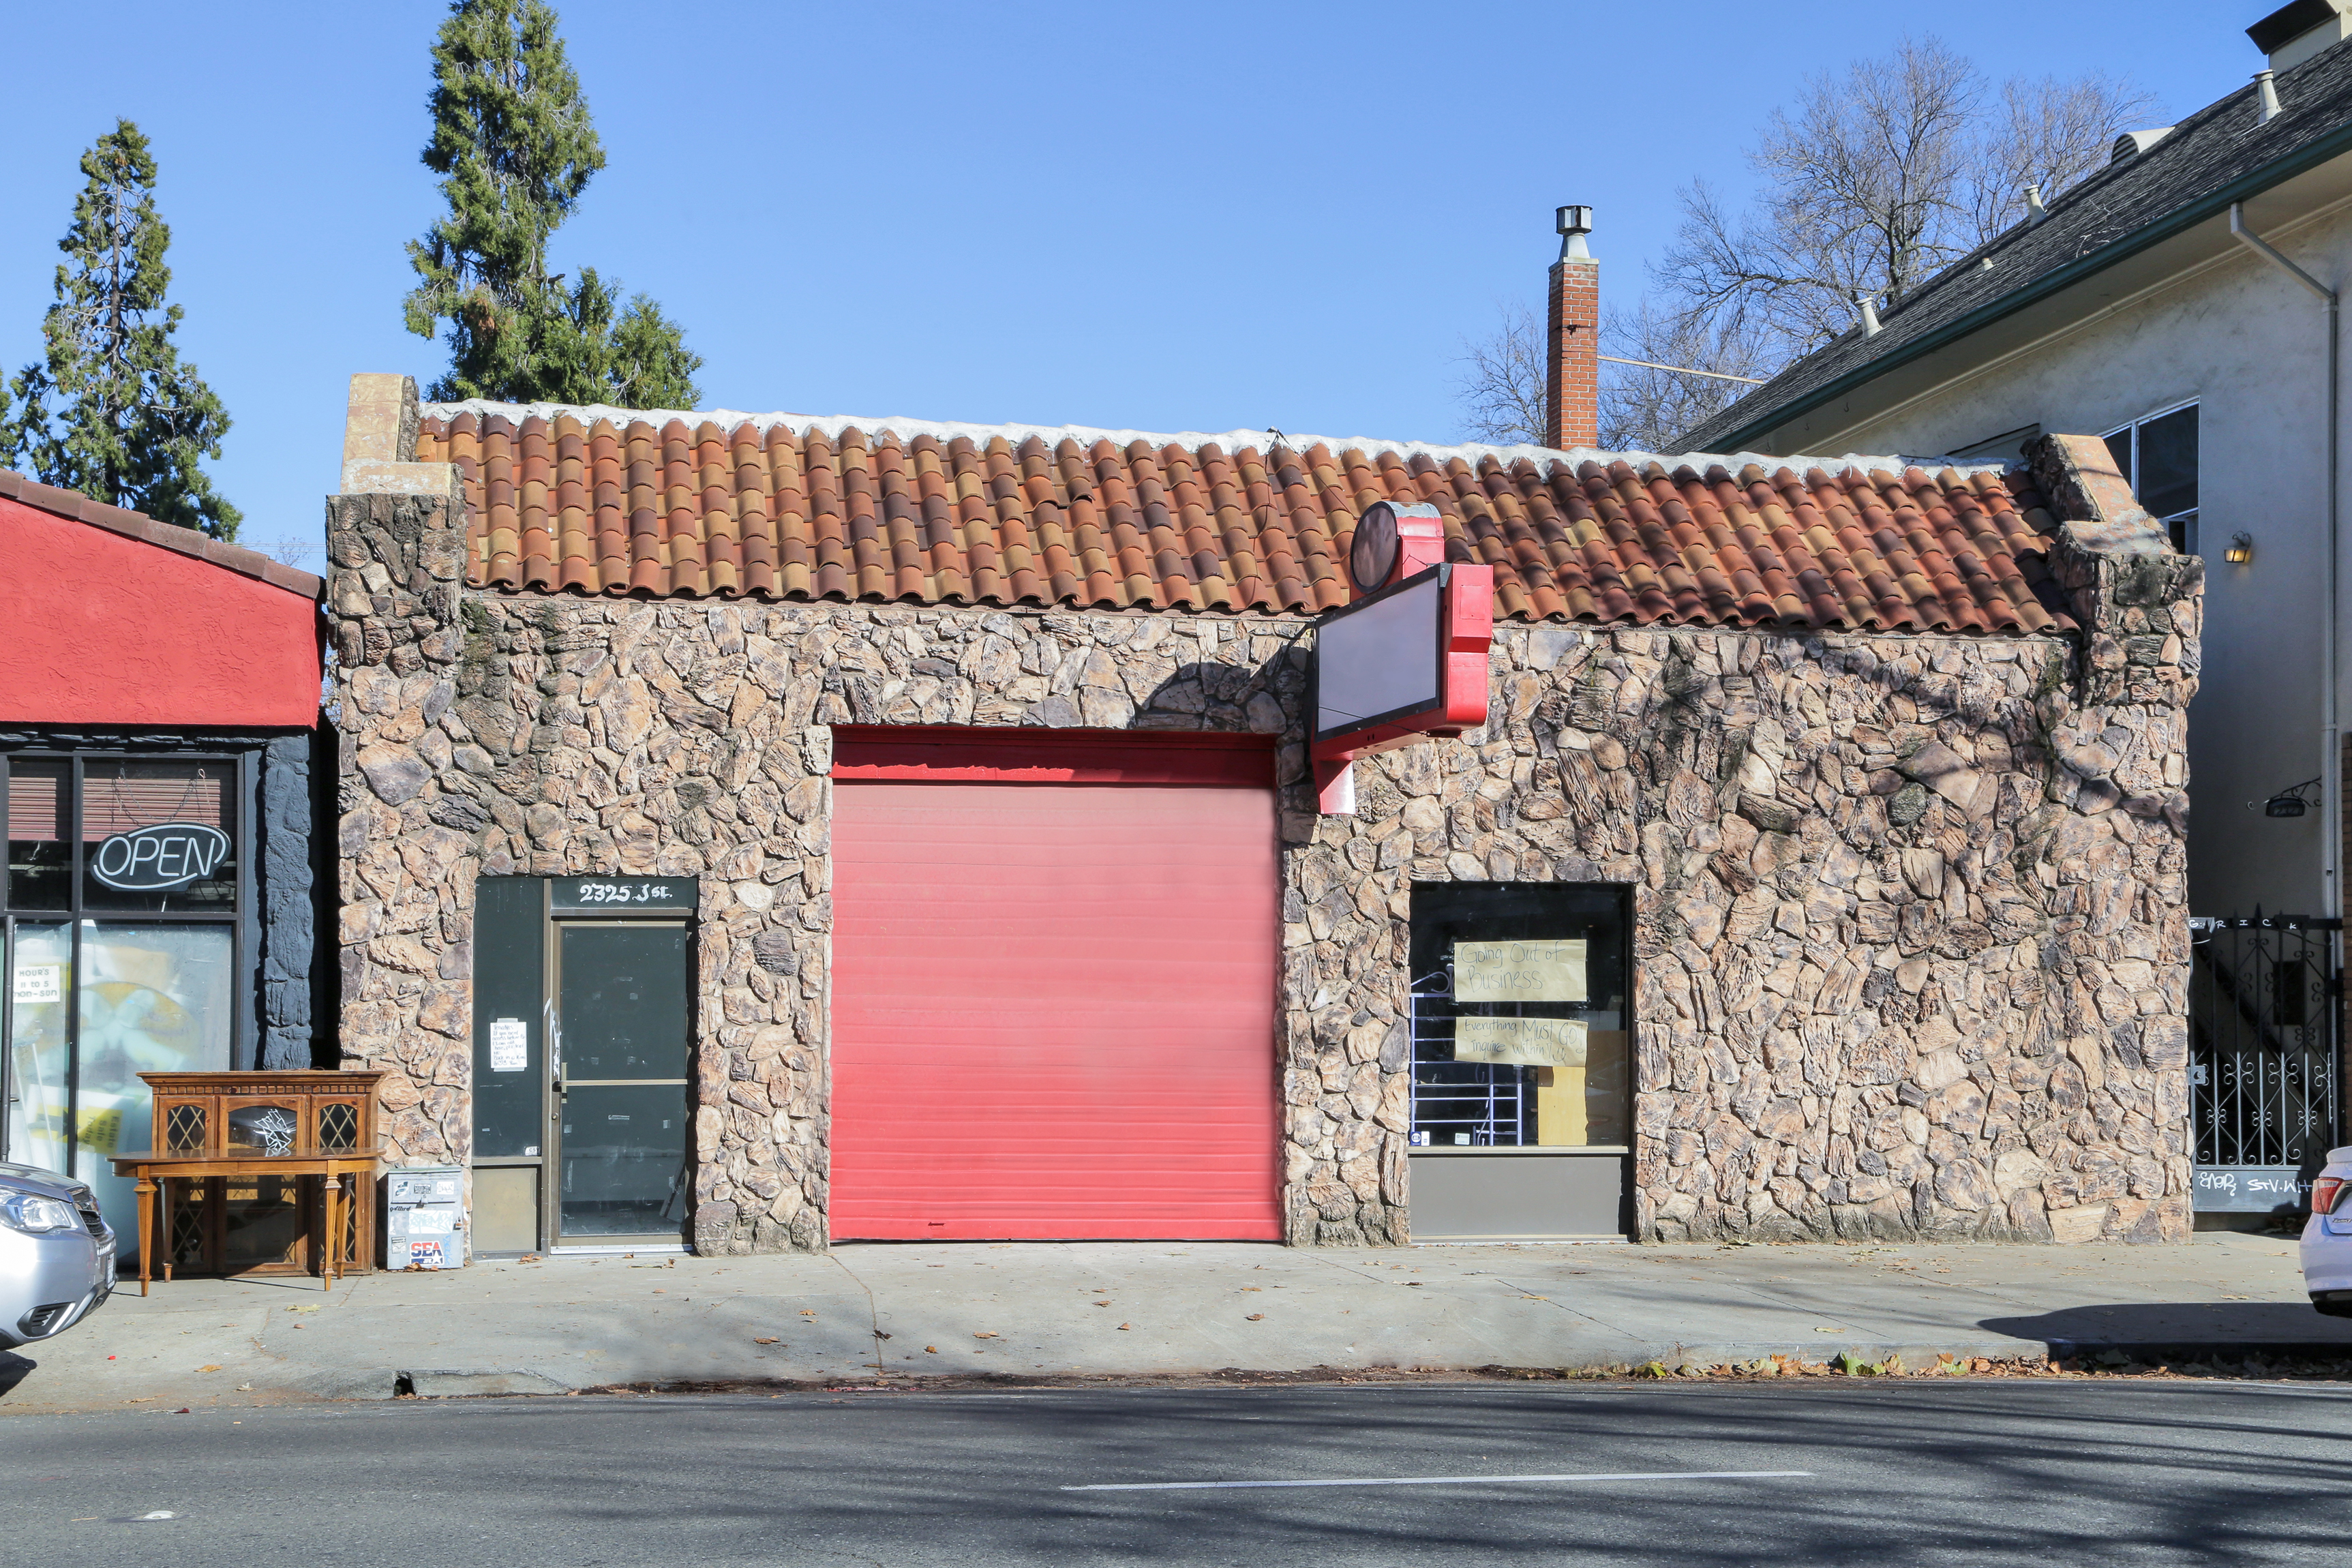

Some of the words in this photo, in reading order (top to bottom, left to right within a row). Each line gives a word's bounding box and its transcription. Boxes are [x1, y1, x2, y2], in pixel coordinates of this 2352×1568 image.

[99, 836, 215, 877] OPEN
[579, 883, 632, 903] 2325
[1460, 943, 1503, 969] Going
[1509, 943, 1541, 963] Out
[1545, 940, 1566, 961] of
[19, 968, 49, 976] HOUR'S
[1468, 965, 1543, 993] Business
[1465, 1019, 1517, 1037] Everything
[1522, 1019, 1554, 1042] Must
[96, 1120, 107, 1141] Sale
[107, 1116, 120, 1148] Estate
[411, 1241, 442, 1257] SEA
